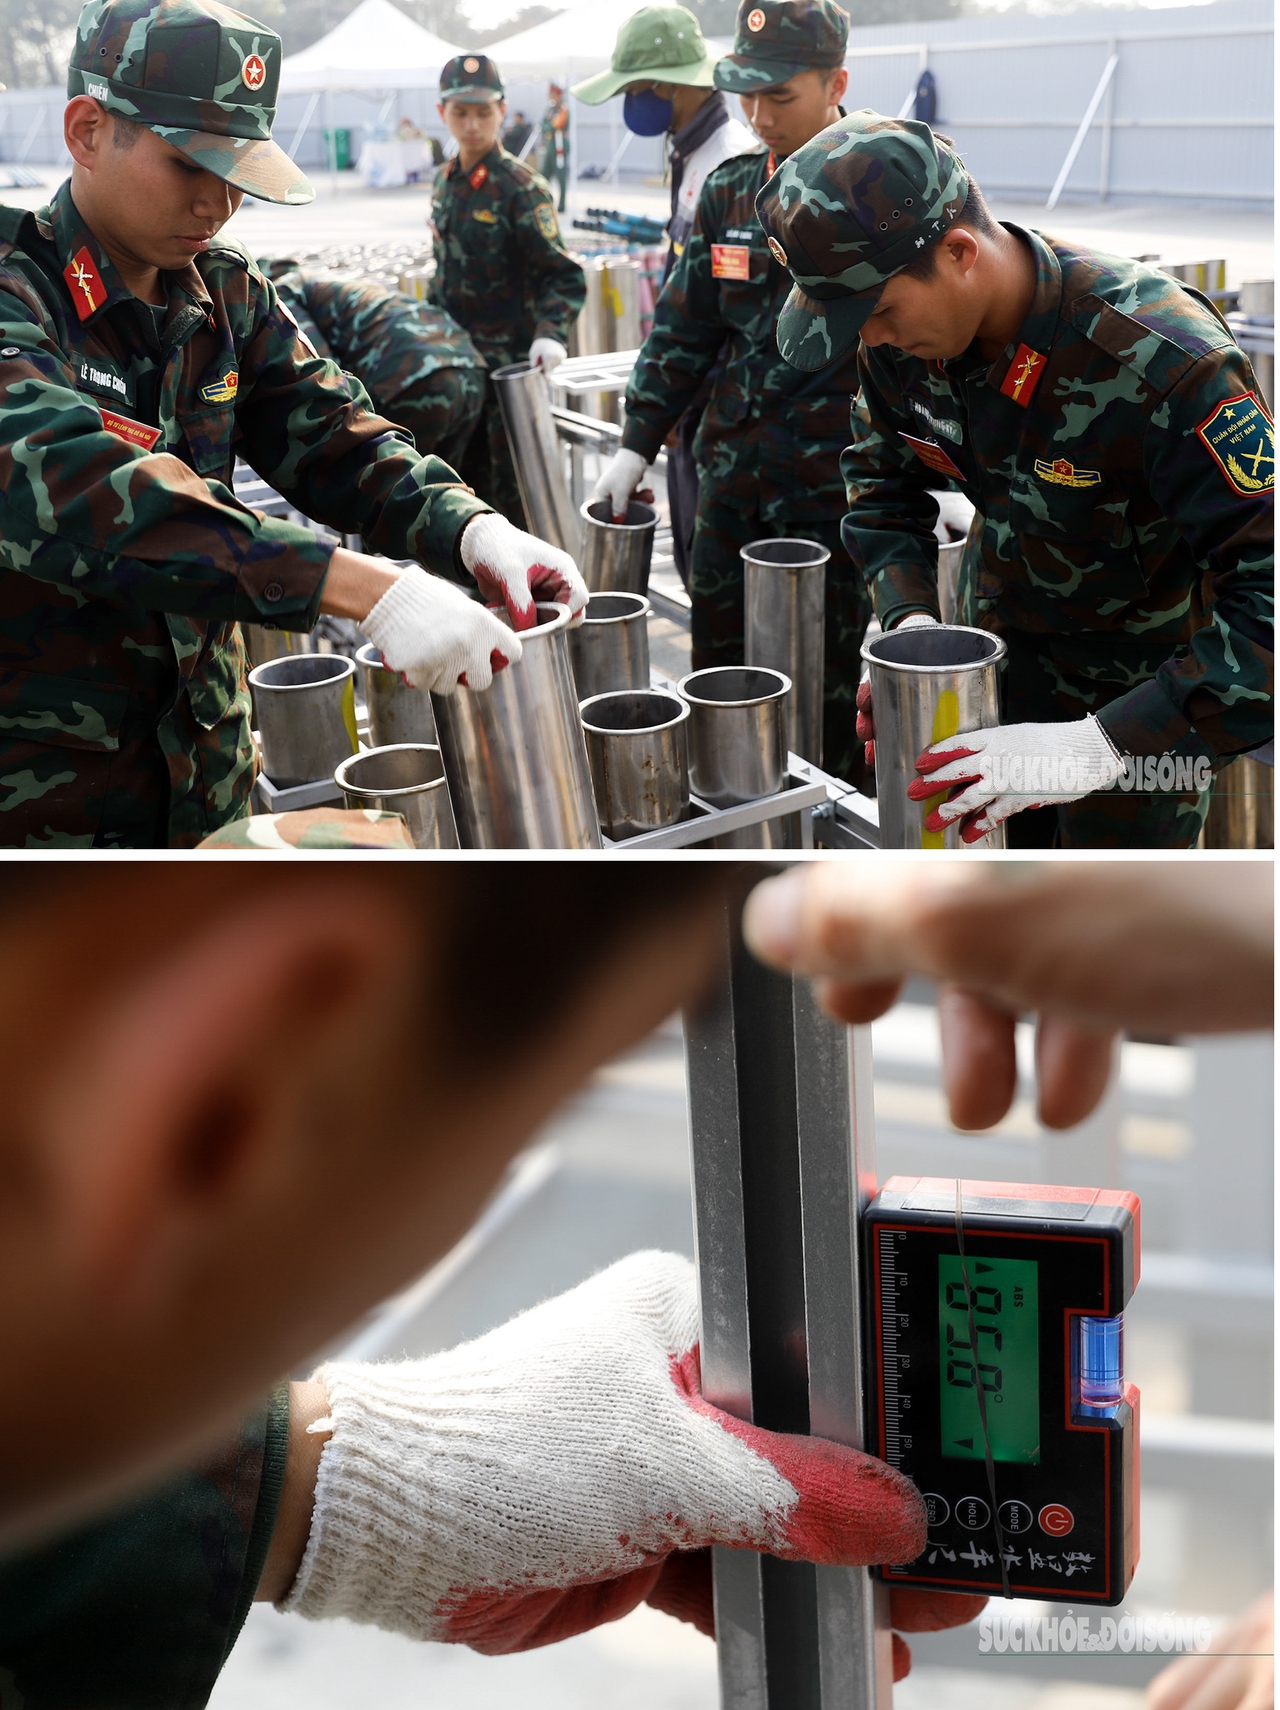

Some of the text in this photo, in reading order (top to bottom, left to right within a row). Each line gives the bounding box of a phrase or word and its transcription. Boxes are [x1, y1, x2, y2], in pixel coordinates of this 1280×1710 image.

[1212, 408, 1259, 444] QUÂN ĐỘI NHÂN DÂN
[1229, 423, 1257, 445] VIỆT NAM
[899, 1276, 909, 1287] 10
[1013, 1285, 1024, 1308] ABS
[900, 1316, 910, 1329] 20
[901, 1357, 911, 1369] 30
[902, 1397, 912, 1410] 40
[903, 1437, 913, 1449] 50
[927, 1498, 937, 1523] ZERO
[967, 1502, 977, 1526] HOLD
[1009, 1505, 1019, 1531] MODE
